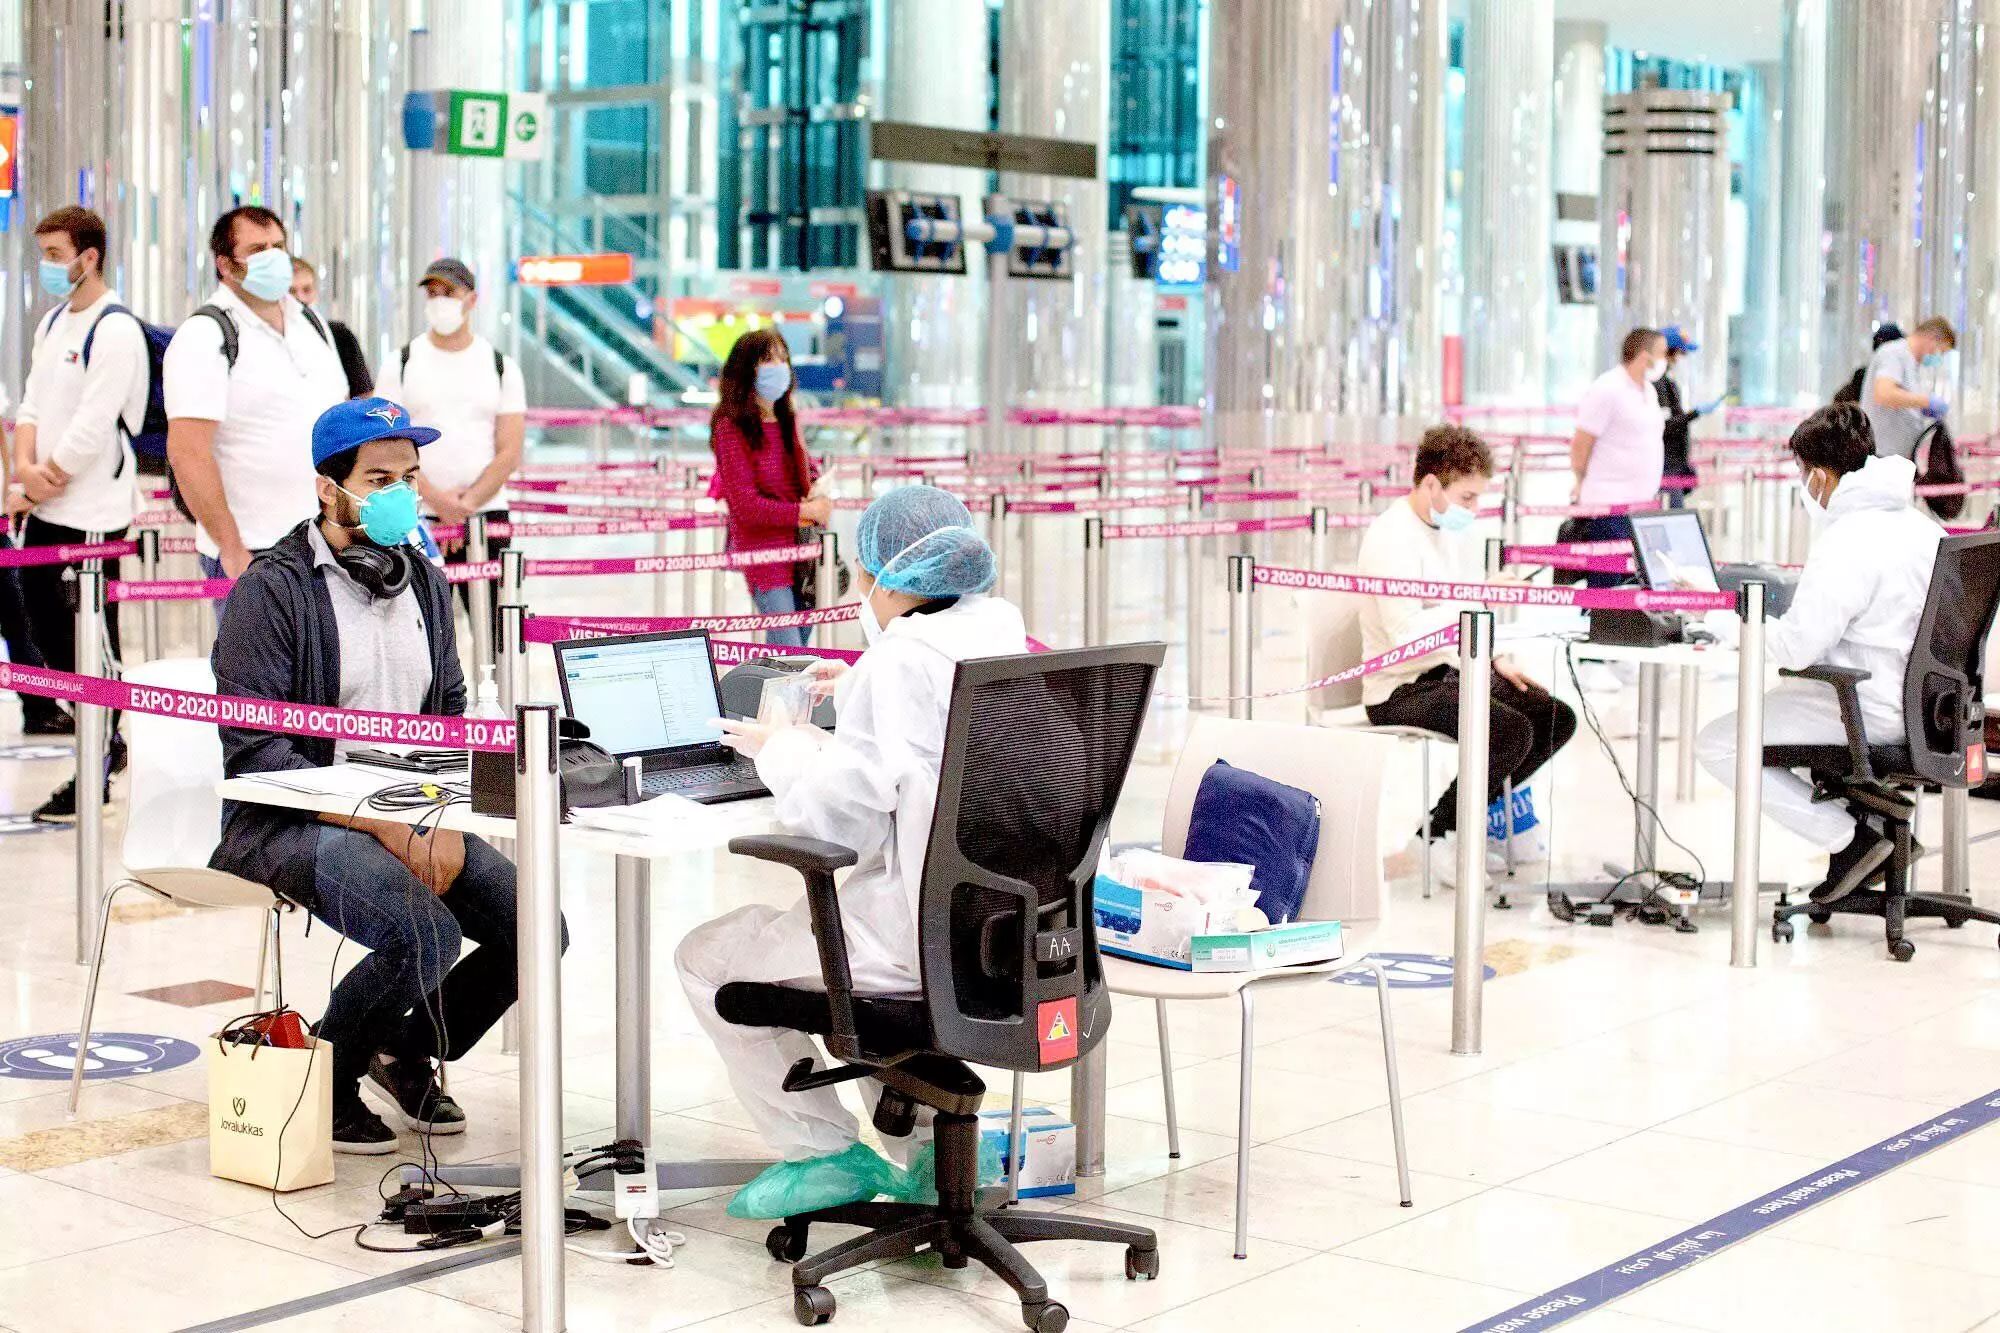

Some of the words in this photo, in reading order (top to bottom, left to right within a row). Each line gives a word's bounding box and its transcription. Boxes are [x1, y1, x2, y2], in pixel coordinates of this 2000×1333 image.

[634, 558, 664, 572] EXPO
[666, 558, 692, 571] 2020
[731, 553, 751, 566] THE
[752, 548, 797, 565] WORLD'S
[1270, 569, 1305, 586] 2020
[1356, 578, 1382, 593] THE
[1385, 580, 1450, 599] WORLD'S
[1453, 585, 1525, 602] GREATEST
[1528, 589, 1576, 605] SHOW
[569, 627, 604, 639] VIS
[690, 619, 726, 633] EXPO
[726, 617, 761, 632] 2020
[806, 611, 823, 624] 20
[1380, 651, 1400, 667] 10
[1403, 632, 1450, 659] APRIL
[130, 688, 174, 713] EXPO
[177, 694, 218, 718] 2020
[221, 700, 278, 726] DUBAI:
[282, 707, 305, 729] 20
[308, 711, 393, 739] OCTOBER
[397, 718, 445, 742] 2020
[464, 723, 487, 745] 10
[1049, 936, 1071, 959] AA
[1810, 1169, 1860, 1188] Please
[1782, 1186, 1820, 1202] wait
[1752, 1199, 1798, 1215] here
[1521, 1294, 1587, 1320] Please
[1482, 1318, 1532, 1333] wa
